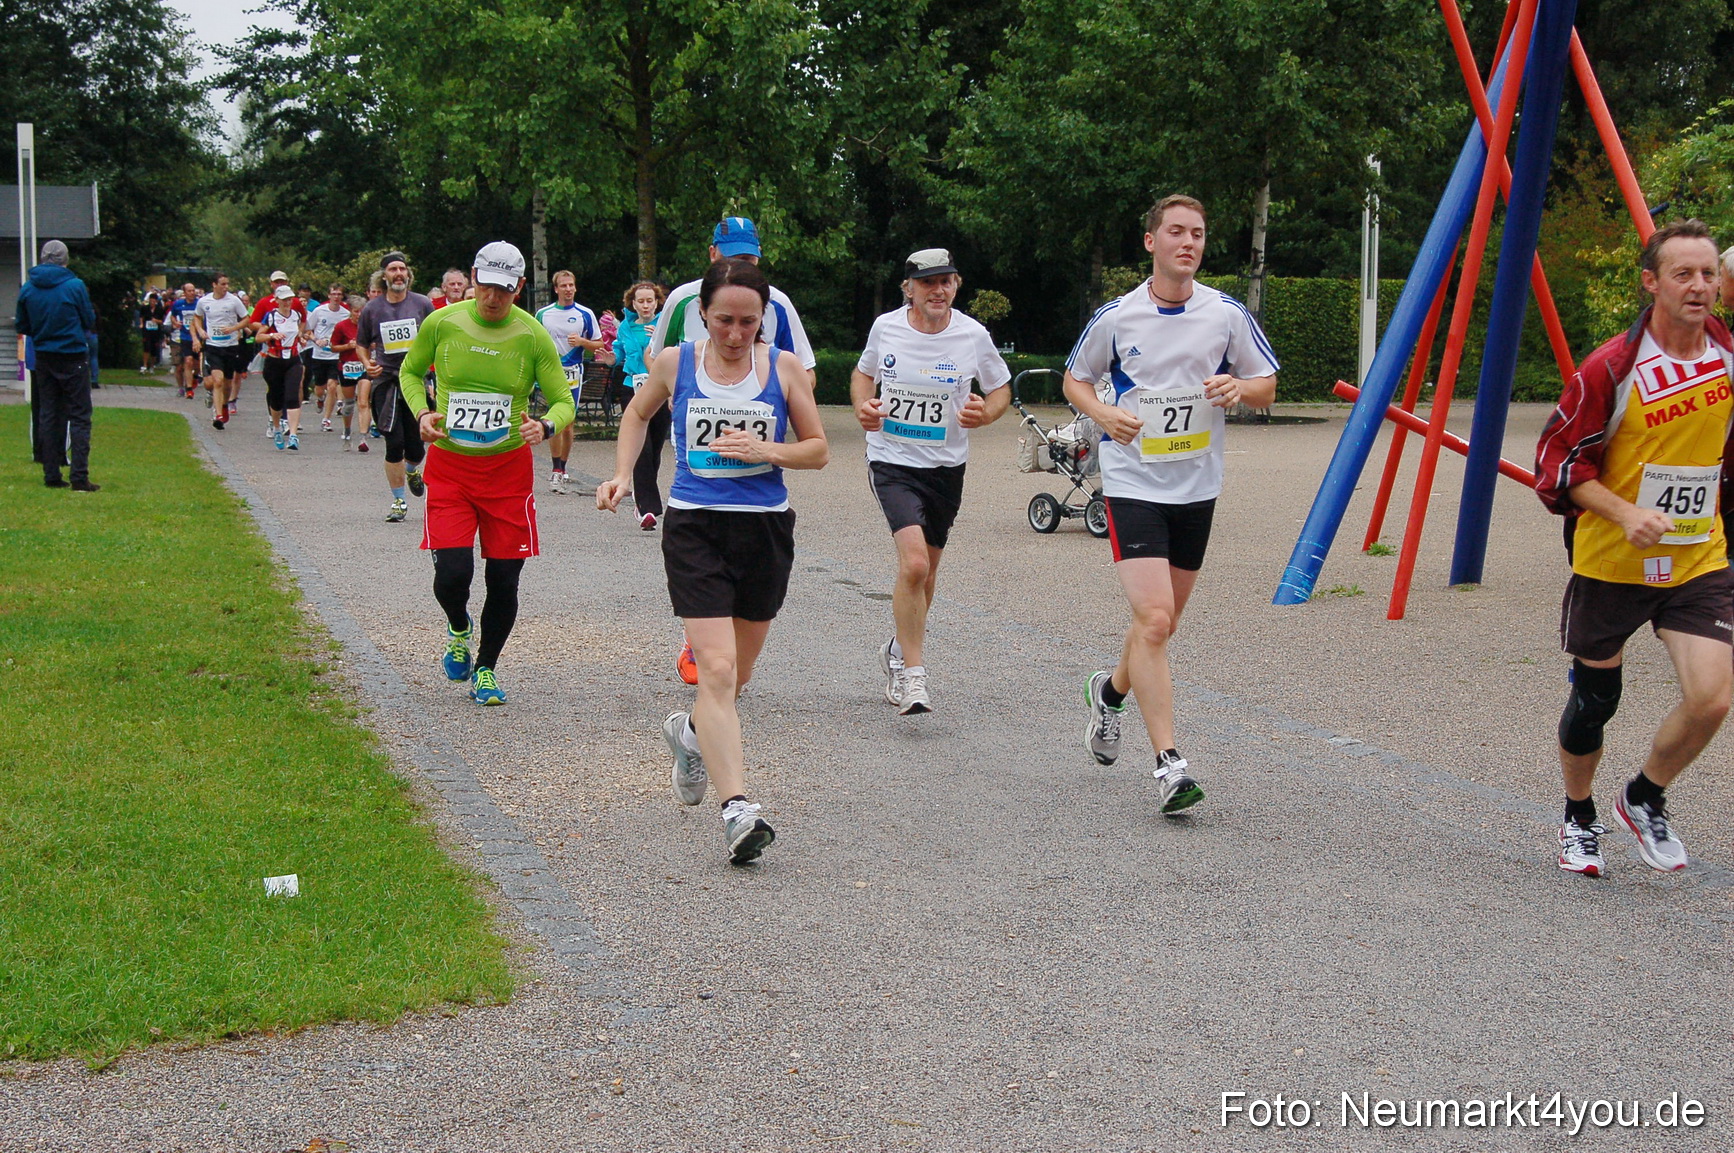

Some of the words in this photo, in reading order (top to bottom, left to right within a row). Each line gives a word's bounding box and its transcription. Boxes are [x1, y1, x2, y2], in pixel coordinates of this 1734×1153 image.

[487, 260, 515, 271] saller
[388, 327, 411, 341] 583
[469, 345, 500, 356] saller
[907, 391, 939, 399] Neumarkt
[1139, 396, 1165, 405] PARTL
[1166, 393, 1202, 403] Neumarkt
[689, 406, 718, 415] PARTL
[719, 407, 761, 416] Neumarkt
[888, 397, 943, 424] 2713
[1644, 396, 1699, 429] MAX
[452, 407, 506, 429] 2719
[1163, 405, 1193, 434] 27
[894, 425, 932, 438] Klemens
[1168, 440, 1192, 451] Jens
[1644, 471, 1674, 481] PARTL
[1675, 474, 1711, 483] Neumarkt
[1655, 486, 1706, 515] 459
